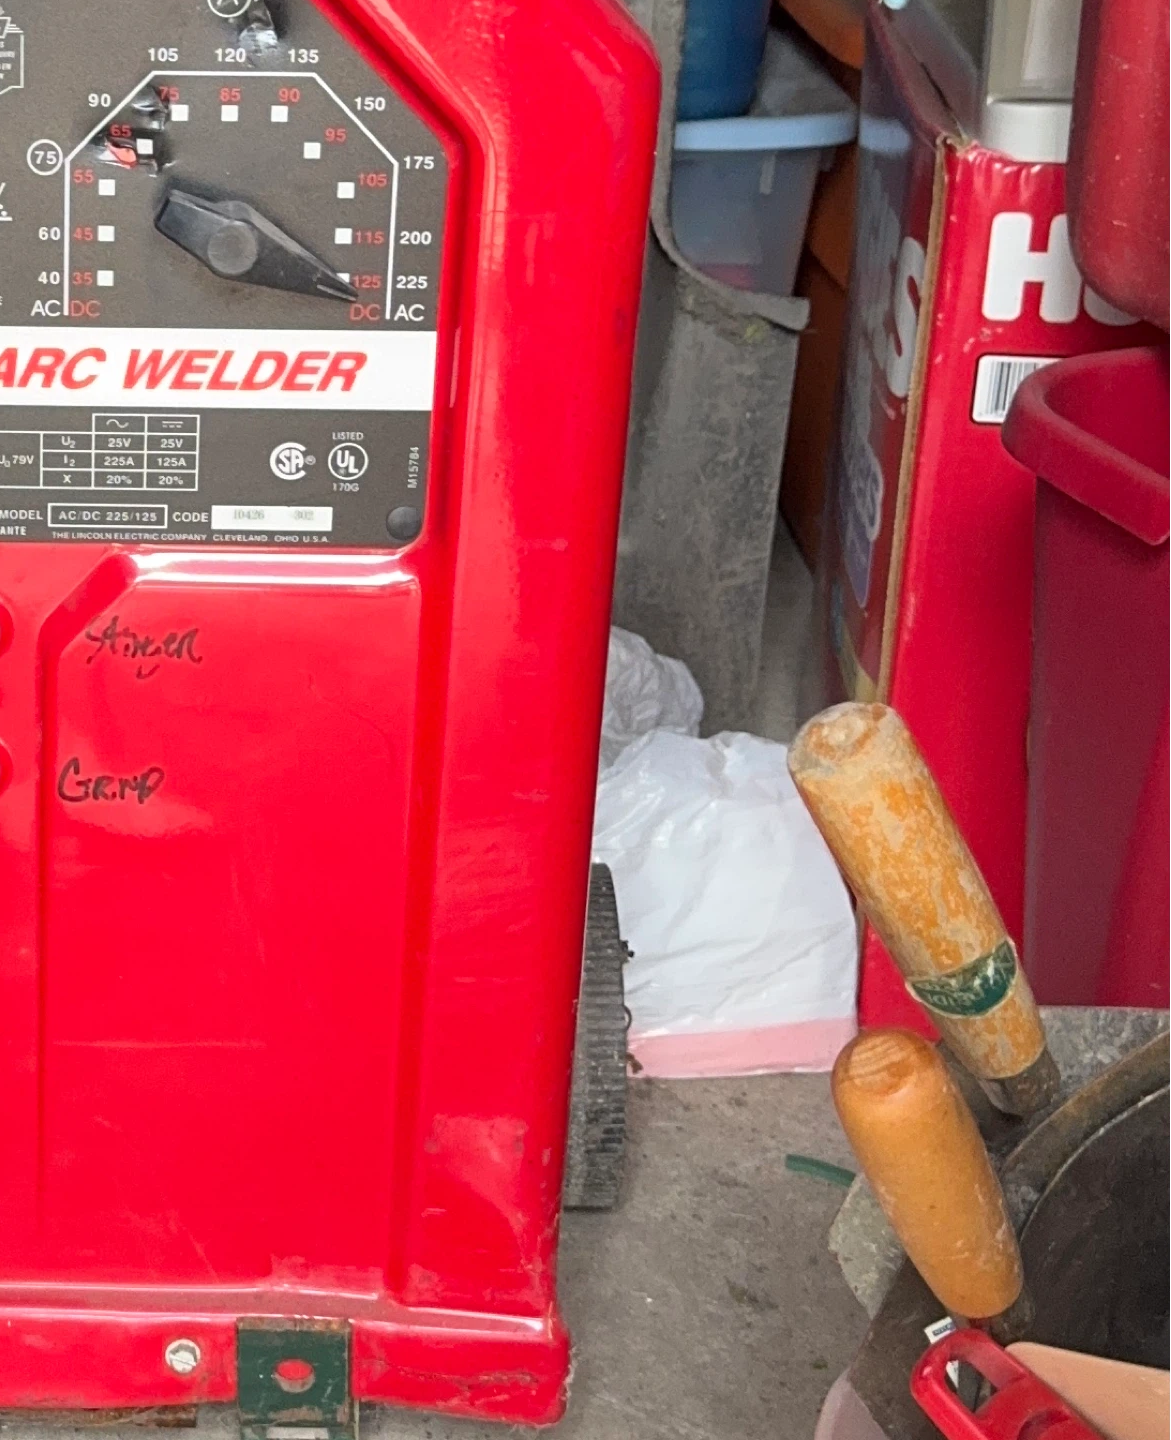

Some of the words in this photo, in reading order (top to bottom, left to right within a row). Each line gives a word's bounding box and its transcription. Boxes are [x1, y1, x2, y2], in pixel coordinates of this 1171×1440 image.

[148, 47, 179, 63] 105
[215, 48, 246, 63] 120
[288, 48, 319, 64] 135
[87, 93, 112, 108] 90
[159, 86, 180, 101] 75
[220, 87, 242, 103] 85
[279, 88, 301, 103] 90
[354, 96, 386, 112] 150
[109, 124, 132, 137] 65
[324, 127, 348, 143] 95
[34, 150, 57, 165] 75
[403, 155, 435, 171] 175
[73, 168, 95, 184] 55
[358, 173, 388, 187] 105
[38, 226, 61, 241] 60
[72, 227, 93, 242] 45
[354, 230, 384, 245] 115
[399, 231, 432, 246] 200
[37, 271, 61, 286] 40
[72, 272, 93, 287] 35
[352, 274, 381, 289] 125
[396, 274, 429, 290] 225
[30, 300, 61, 318] AC
[71, 301, 101, 318] DC
[349, 303, 381, 320] DC
[394, 304, 425, 321] AC
[122, 348, 368, 393] WELDER
[107, 437, 132, 448] 25V
[160, 438, 184, 449] 25V
[332, 432, 364, 441] LISTED
[12, 455, 34, 465] 79V
[103, 456, 135, 467] 225A
[157, 456, 187, 467] 125A
[336, 449, 359, 474] UL
[407, 446, 420, 489] M15784
[105, 474, 133, 485] 20%
[158, 475, 184, 486] 20%
[332, 482, 360, 492] 170G
[58, 510, 101, 522] AC/DC
[105, 511, 158, 522] 225/125
[172, 511, 209, 523] CODE
[52, 531, 71, 540] THE
[71, 532, 113, 541] LINCOLN
[113, 532, 160, 541] ELECTRIC
[161, 533, 208, 542] COMPANY
